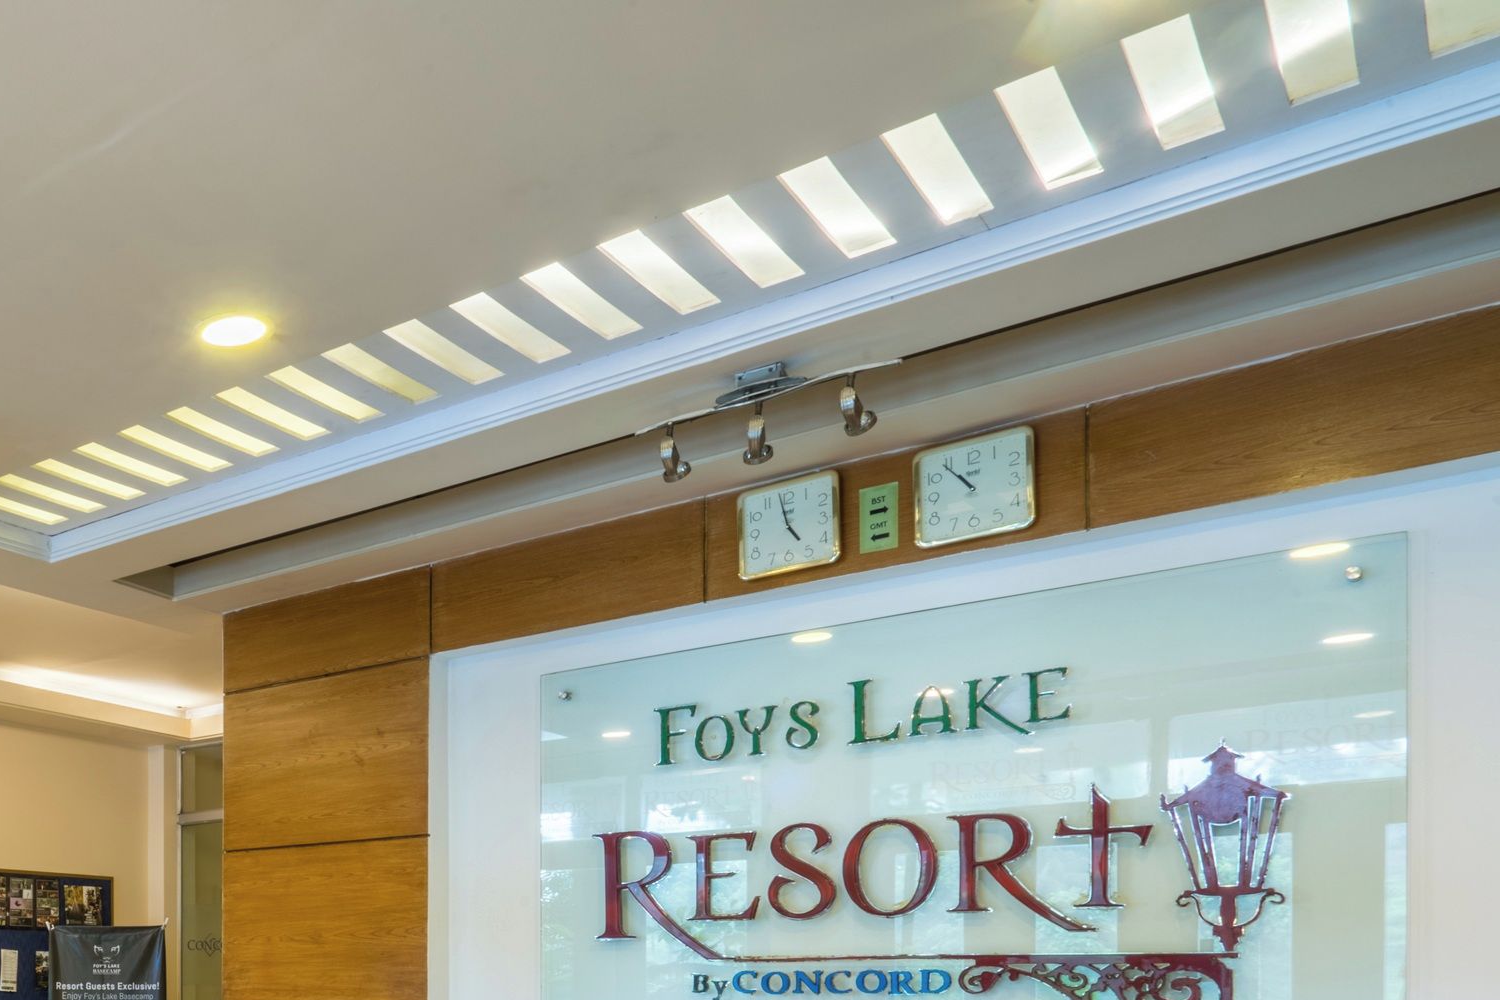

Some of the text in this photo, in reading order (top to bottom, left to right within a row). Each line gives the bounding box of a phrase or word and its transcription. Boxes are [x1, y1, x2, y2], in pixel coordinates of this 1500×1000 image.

[944, 456, 953, 471] 11
[967, 450, 981, 466] 12
[1008, 451, 1020, 467] 2
[927, 472, 943, 486] 10
[1008, 471, 1021, 487] 3
[764, 497, 772, 510] 11
[783, 491, 795, 505] 12
[818, 492, 828, 507] 2
[871, 495, 886, 505] BST
[928, 491, 940, 505] 9
[1010, 492, 1020, 507] 4
[749, 511, 763, 524] 10
[818, 511, 829, 525] 3
[928, 511, 941, 526] 8
[968, 513, 981, 528] 6
[992, 508, 1003, 523] 5
[870, 521, 887, 530] GMT
[950, 517, 958, 532] 7
[750, 529, 760, 541] 9
[820, 530, 828, 544] 4
[750, 547, 761, 560] 8
[784, 549, 795, 562] 6
[804, 544, 814, 558] 5
[768, 552, 776, 565] 7
[653, 666, 1073, 766] FOYS LAKE
[591, 782, 1153, 958] RESORT
[187, 939, 222, 951] CONC
[56, 982, 160, 990] Resort Guests Exclusive!
[691, 968, 953, 1000] By CONCORD
[61, 992, 154, 1000] Enjoy Foy's Lake Basecamp
